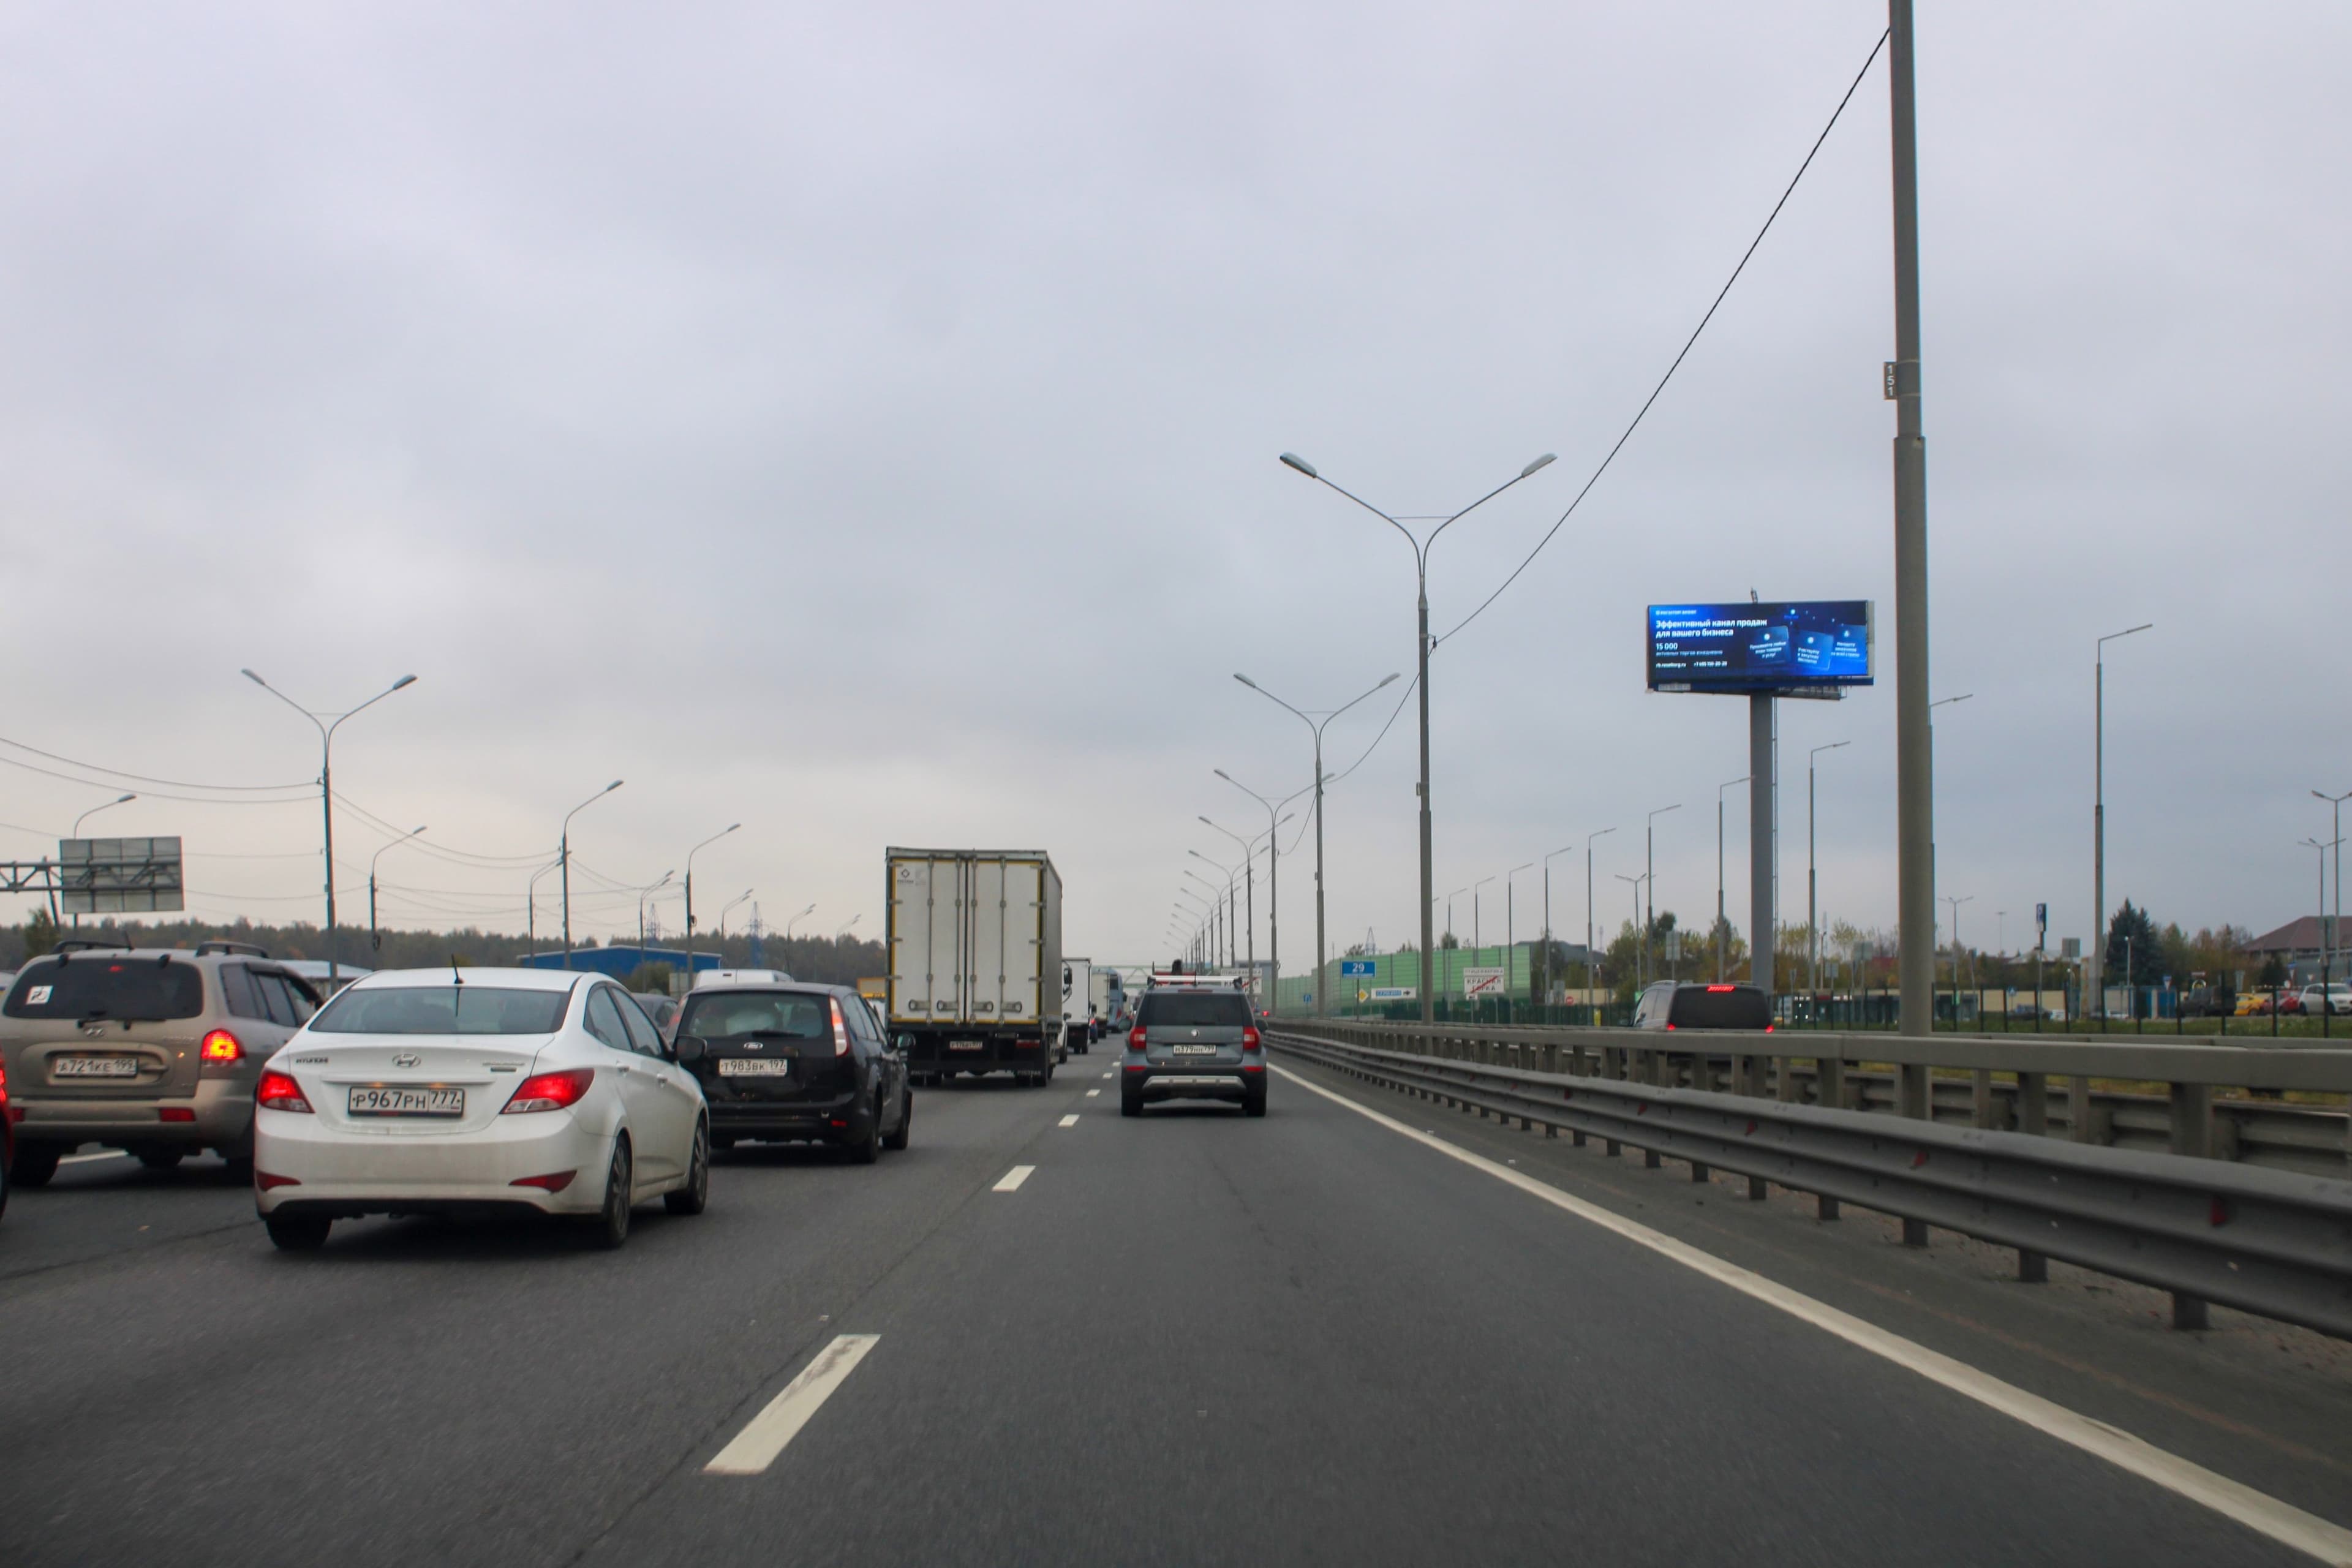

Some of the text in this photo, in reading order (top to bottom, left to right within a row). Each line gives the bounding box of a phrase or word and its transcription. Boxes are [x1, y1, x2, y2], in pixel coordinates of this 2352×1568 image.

[1656, 619, 1711, 629] Эффективный
[1736, 619, 1767, 628] продаж
[1352, 962, 1365, 973] 29
[769, 1059, 785, 1068] 197
[356, 1090, 458, 1108] Р967РН 777
